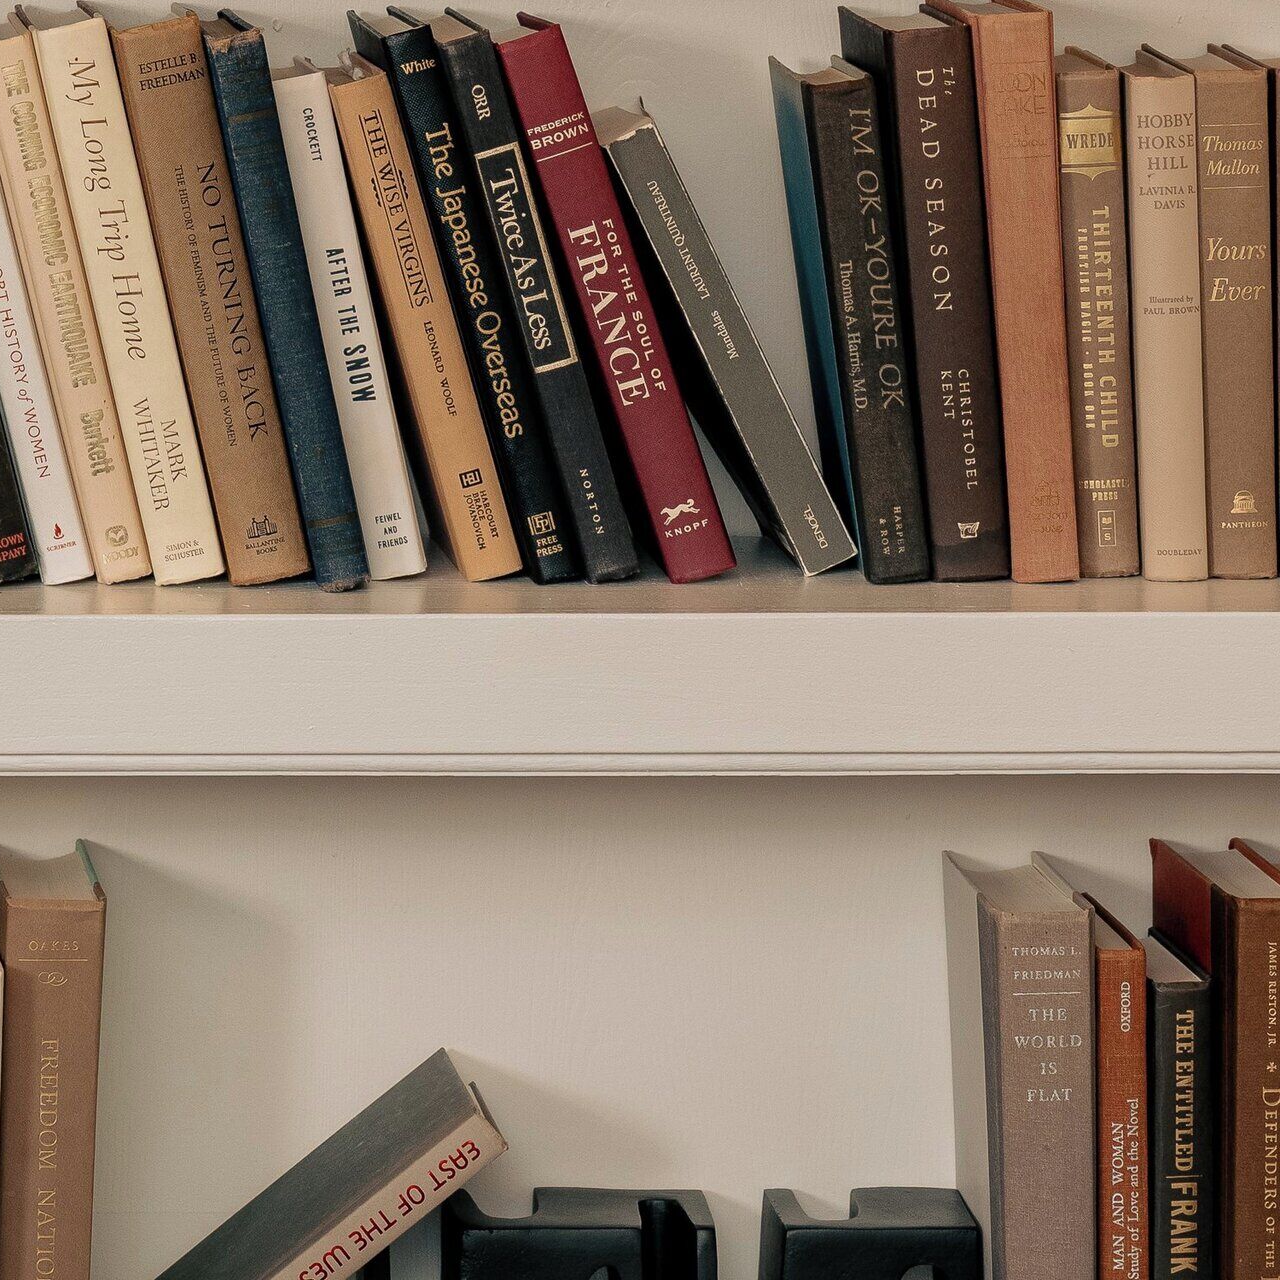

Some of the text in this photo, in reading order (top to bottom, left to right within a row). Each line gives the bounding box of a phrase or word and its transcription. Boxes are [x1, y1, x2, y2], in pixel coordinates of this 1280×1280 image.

[400, 56, 436, 75] White
[471, 83, 492, 121] ORR
[302, 107, 323, 162] CROCKETT
[527, 112, 585, 136] FREDERICK
[1137, 113, 1193, 130] HOBBY
[530, 123, 589, 149] BROWN
[1138, 135, 1194, 150] HORSE
[1203, 135, 1264, 154] Thomas
[1147, 156, 1189, 171] HILL
[1206, 159, 1260, 176] Mallon
[65, 59, 148, 360] My Long Trip Home
[1206, 239, 1267, 263] Yours
[425, 123, 524, 440] The Japanese Overseas
[1210, 278, 1266, 302] Ever
[197, 162, 269, 441] NO TURNING BACK
[567, 220, 650, 407] FRANCE
[324, 247, 376, 403] AFTER THE SNOW
[664, 519, 709, 538] KNOPF
[1121, 981, 1131, 1032] OXFORD
[1175, 1010, 1196, 1172] THE ENTITLED
[1112, 1122, 1124, 1270] MAN AND WOMAN
